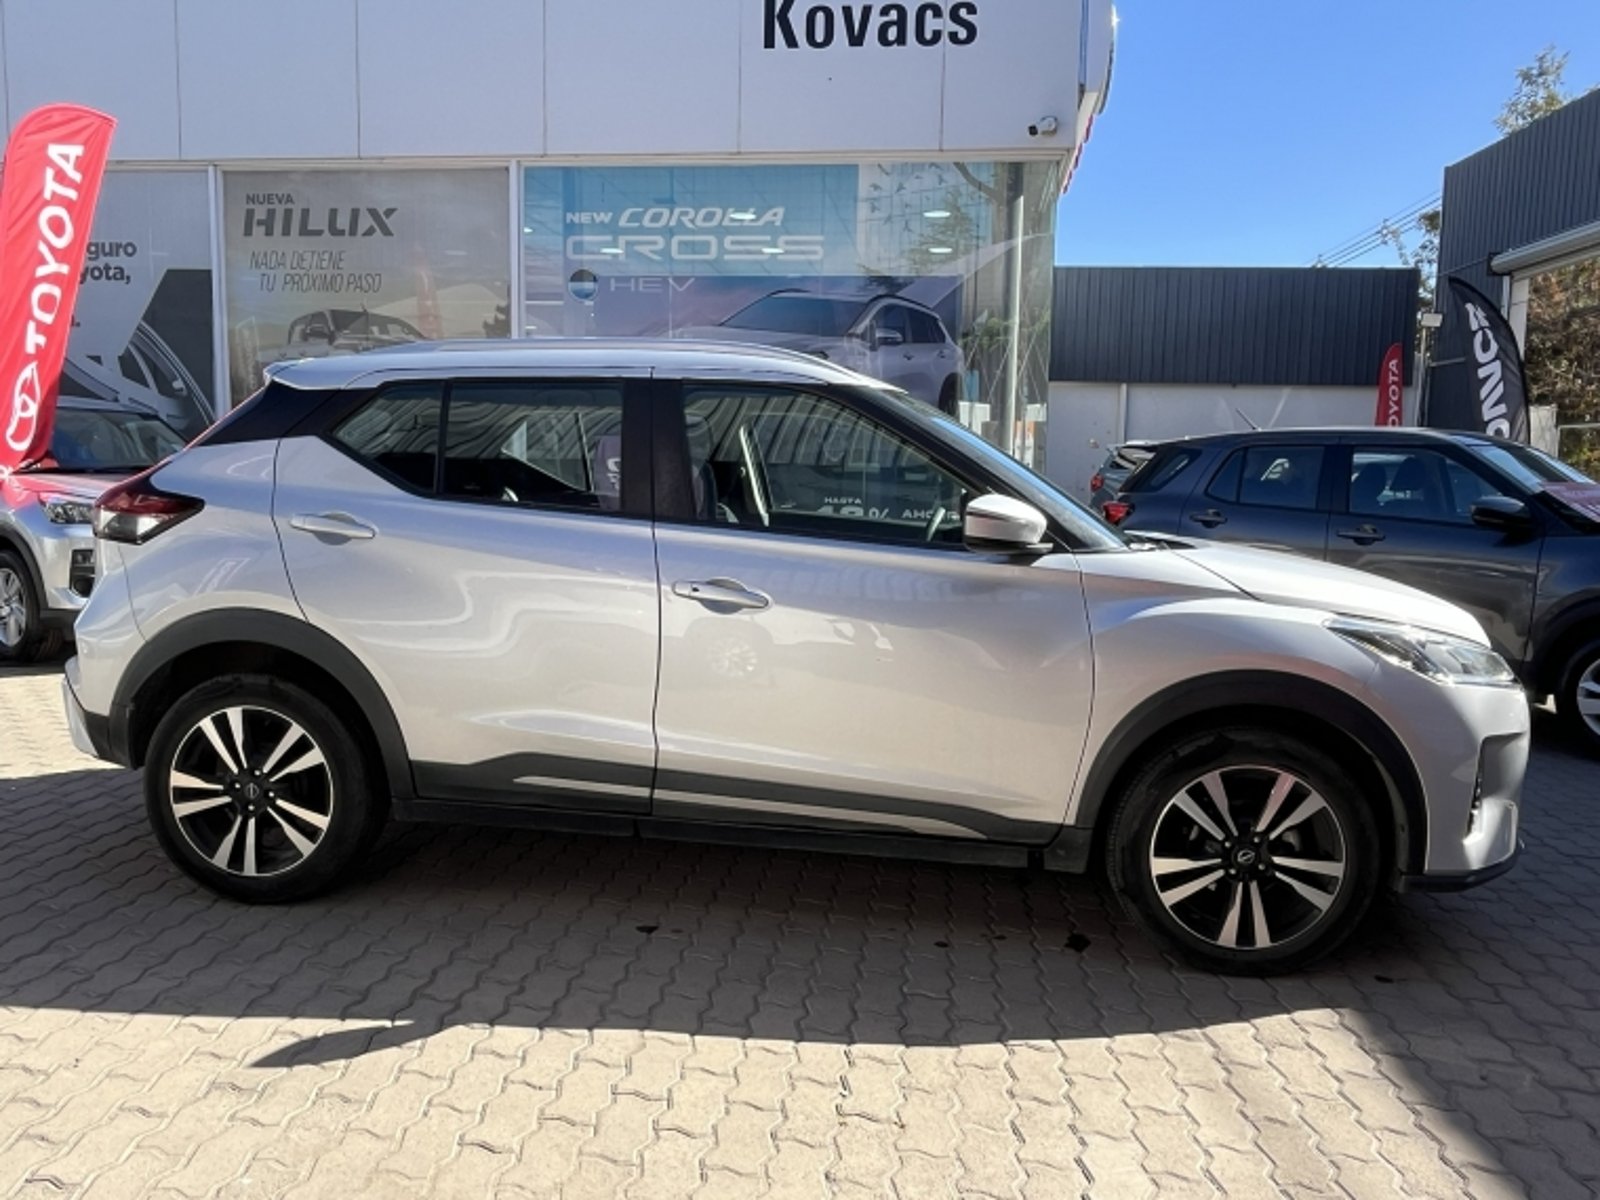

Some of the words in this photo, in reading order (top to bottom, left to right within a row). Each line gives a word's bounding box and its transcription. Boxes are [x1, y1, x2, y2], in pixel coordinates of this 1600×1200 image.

[763, 0, 978, 49] Kovacs
[246, 193, 295, 205] NUEVA
[243, 207, 398, 237] HILUX
[566, 212, 612, 224] NEW
[618, 207, 785, 229] COROLLA
[25, 143, 84, 354] TOYOTA
[566, 235, 824, 260] CROSS
[250, 250, 287, 270] NADA
[290, 250, 346, 271] DETIENE
[260, 273, 276, 292] TU
[345, 273, 382, 293] PASO
[609, 278, 695, 292] HEV
